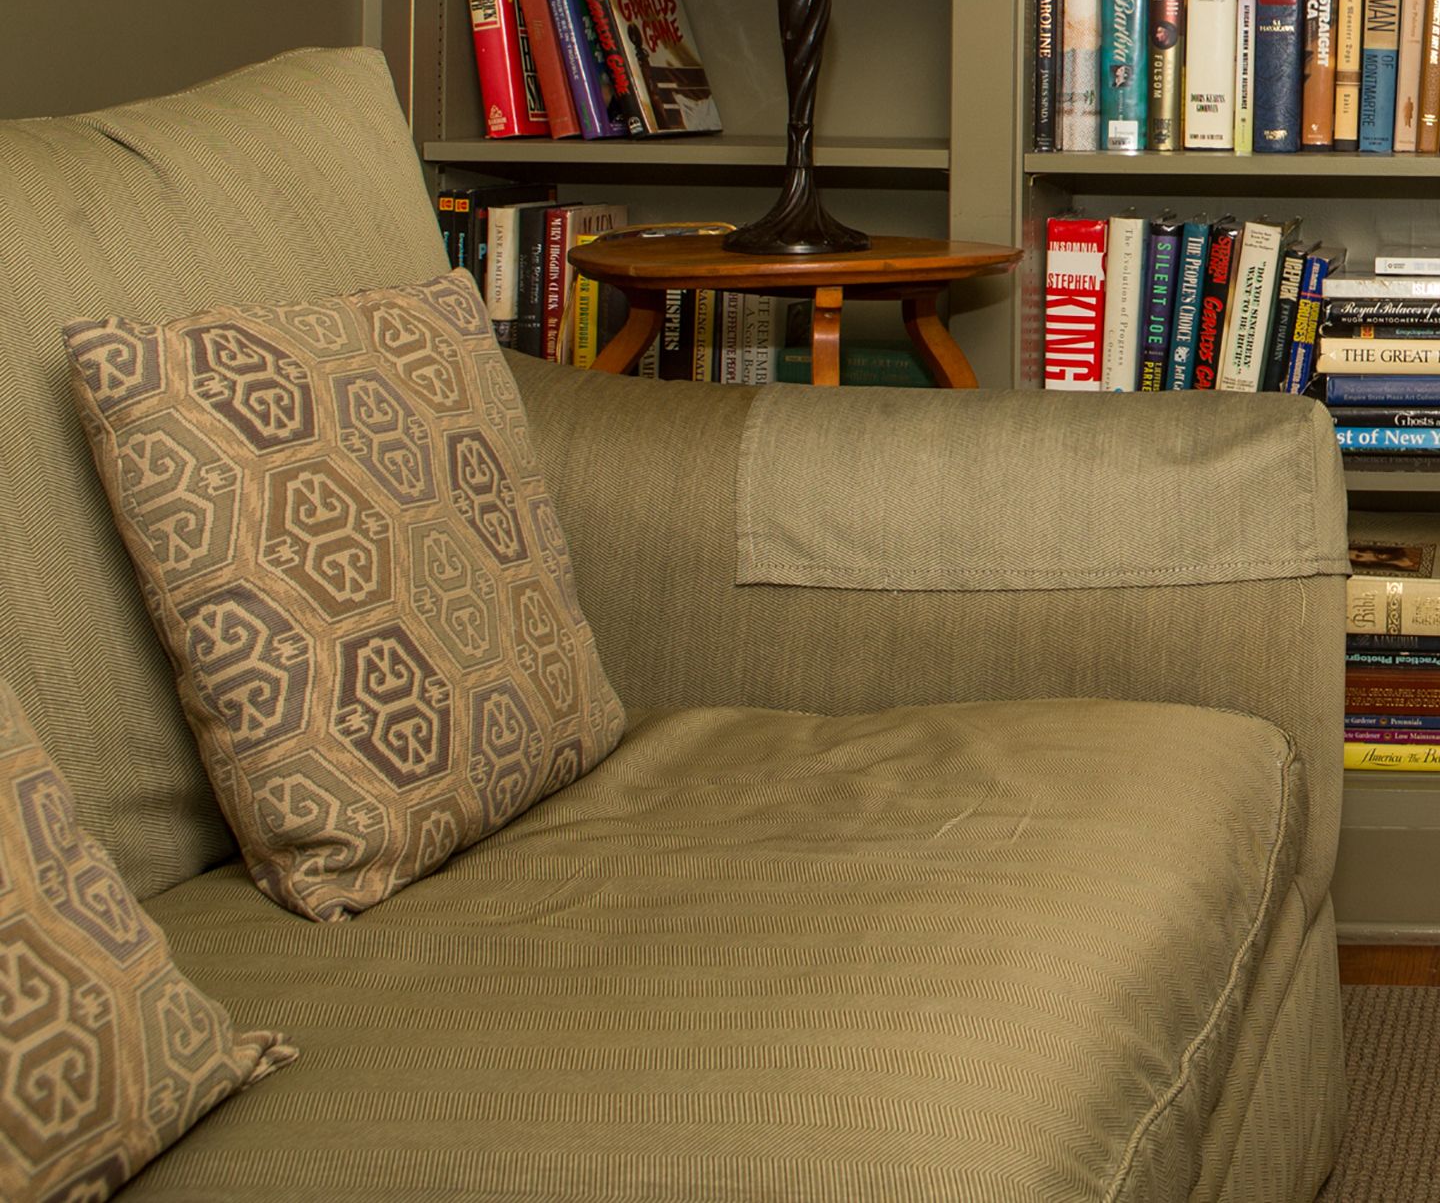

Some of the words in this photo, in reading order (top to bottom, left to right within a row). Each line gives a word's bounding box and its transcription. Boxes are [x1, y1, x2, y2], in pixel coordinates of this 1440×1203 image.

[560, 20, 567, 30] BE
[563, 33, 570, 41] IN
[641, 17, 684, 54] GAME
[1345, 5, 1354, 40] Monster
[566, 44, 579, 80] TROUBLE
[1343, 43, 1353, 64] Dogs
[1381, 54, 1394, 70] OF
[1153, 54, 1163, 99] FOLSOM
[1362, 54, 1378, 127] MONTMARTRE
[495, 224, 503, 249] JANE
[1050, 242, 1098, 253] INSOMNIA
[1124, 229, 1134, 247] The
[1186, 237, 1205, 258] THE
[1152, 242, 1172, 305] SILENT
[1213, 235, 1232, 284] STEPHEN
[495, 251, 503, 304] HAMILTON
[1048, 273, 1097, 290] STEPHEN
[1121, 252, 1133, 303] Evolution
[1180, 258, 1203, 304] PEOPLE'S
[1243, 266, 1256, 297] WANT
[1279, 257, 1304, 302] ICEPICK
[1121, 306, 1129, 317] of
[1241, 298, 1251, 314] TO
[1293, 298, 1312, 343] CRUISES
[726, 310, 737, 355] EFFECTIVE
[1148, 316, 1166, 344] JOE
[1176, 305, 1197, 343] CHOICE
[1198, 297, 1224, 365] GERALD'S
[1239, 315, 1249, 331] BE
[1045, 295, 1097, 383] KING
[1116, 321, 1128, 366] Progress
[1342, 349, 1376, 363] THE
[1380, 350, 1432, 364] GREAT
[1394, 414, 1434, 427] Ghosts
[1336, 430, 1353, 445] st
[1359, 429, 1379, 445] of
[1384, 430, 1426, 445] New
[1360, 748, 1402, 766] America
[1408, 750, 1421, 763] The
